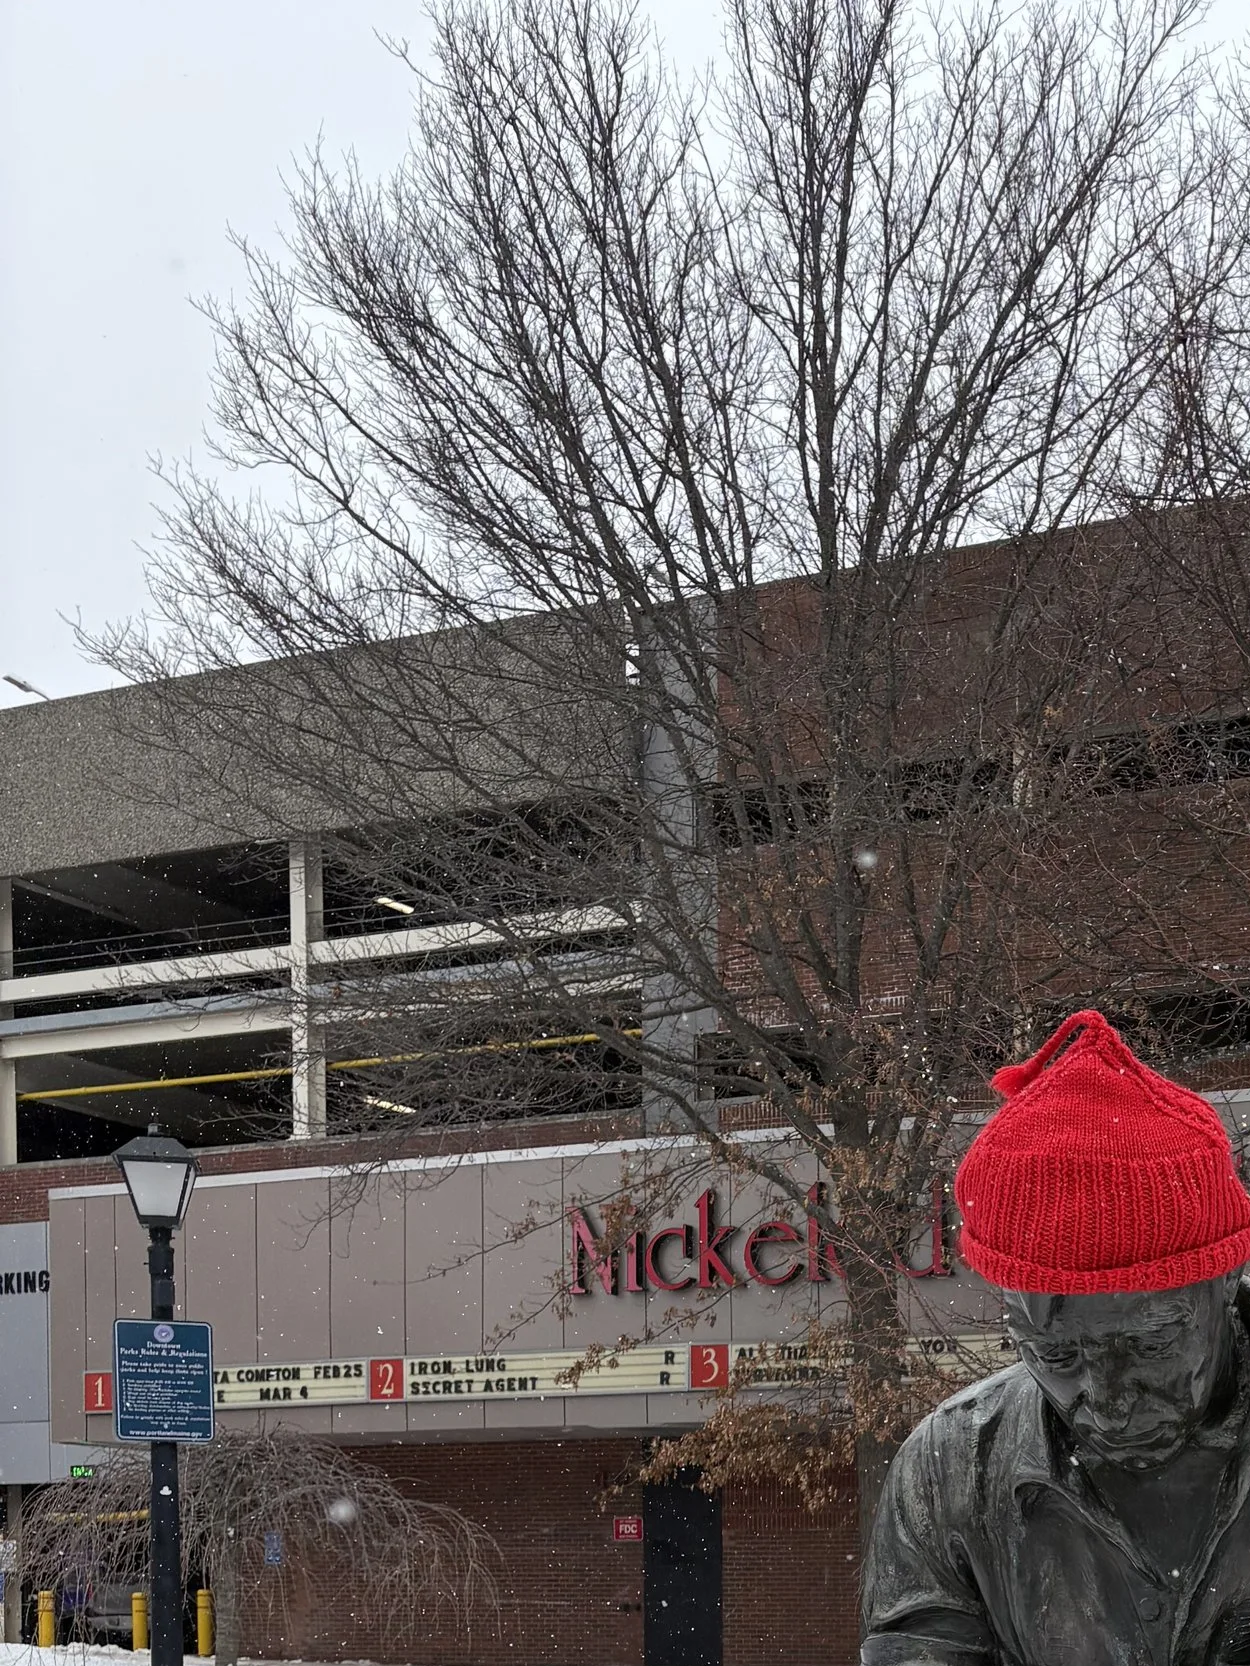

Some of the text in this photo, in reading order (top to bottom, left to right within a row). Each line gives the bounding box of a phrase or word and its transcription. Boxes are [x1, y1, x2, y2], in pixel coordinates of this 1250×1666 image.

[0, 1270, 50, 1295] KING
[120, 1347, 139, 1356] Parks
[141, 1348, 159, 1356] Rules
[169, 1349, 208, 1358] Regulations
[147, 1341, 181, 1349] Downtown
[410, 1350, 675, 1376] IRON LUNG R
[701, 1347, 719, 1383] 3
[378, 1362, 395, 1395] 2
[410, 1371, 671, 1395] SECRET AGENT R
[95, 1376, 105, 1408] 1
[259, 1386, 292, 1401] MAR
[619, 1523, 639, 1534] FDC
